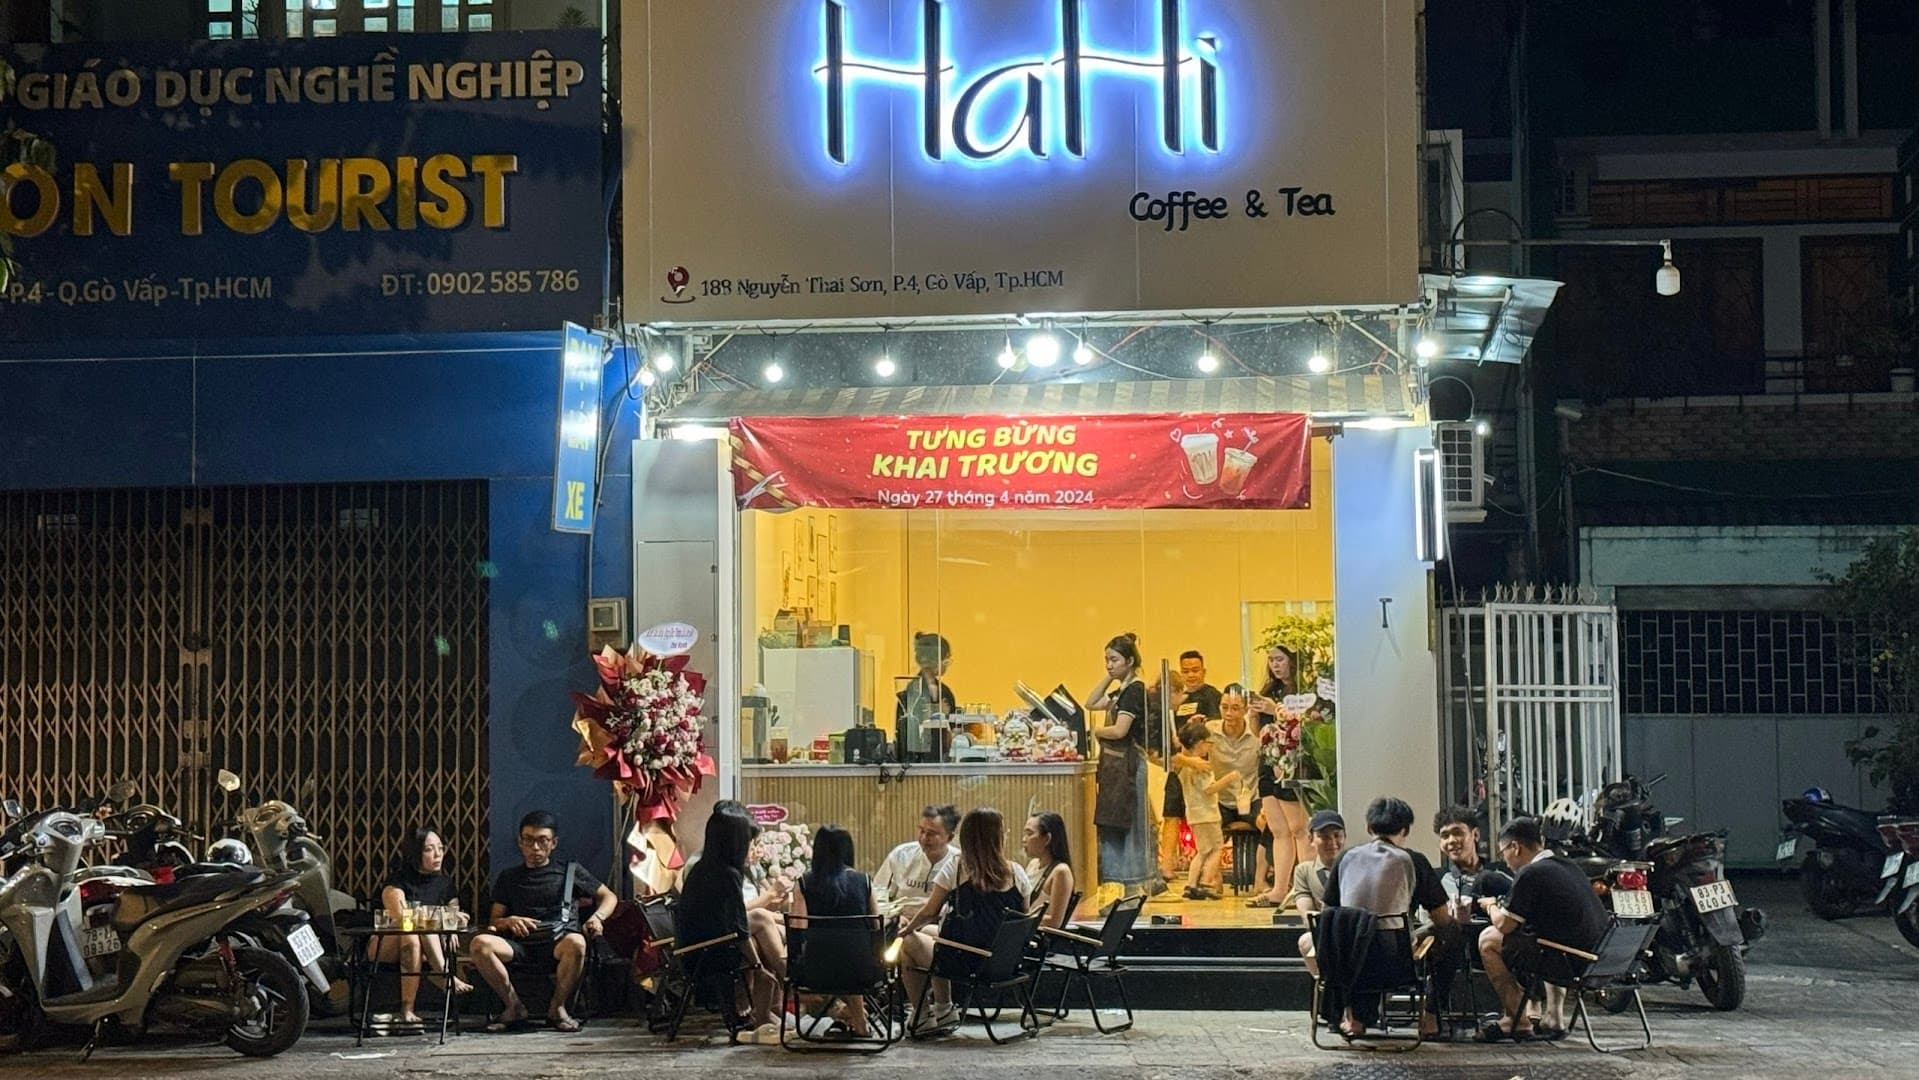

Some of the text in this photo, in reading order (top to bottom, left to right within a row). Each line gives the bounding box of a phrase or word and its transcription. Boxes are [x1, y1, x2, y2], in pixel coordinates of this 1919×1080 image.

[16, 46, 584, 117] GIÁO DỤC NGHỀ NGHIỆP
[813, 0, 1219, 165] HaHi
[168, 153, 519, 236] TOURIST
[1129, 186, 1336, 231] Coffee & Tea
[490, 270, 532, 294] 585
[535, 268, 580, 293] 786
[737, 274, 801, 299] Nguyễn
[994, 269, 1064, 292] Tp.HCM
[906, 419, 1077, 450] TƯNG BỪNG
[871, 449, 1098, 479] KHAI TRƯƠNG
[564, 479, 586, 521] XE
[877, 488, 1095, 507] Ngày 27 tháng 4 năm 2024
